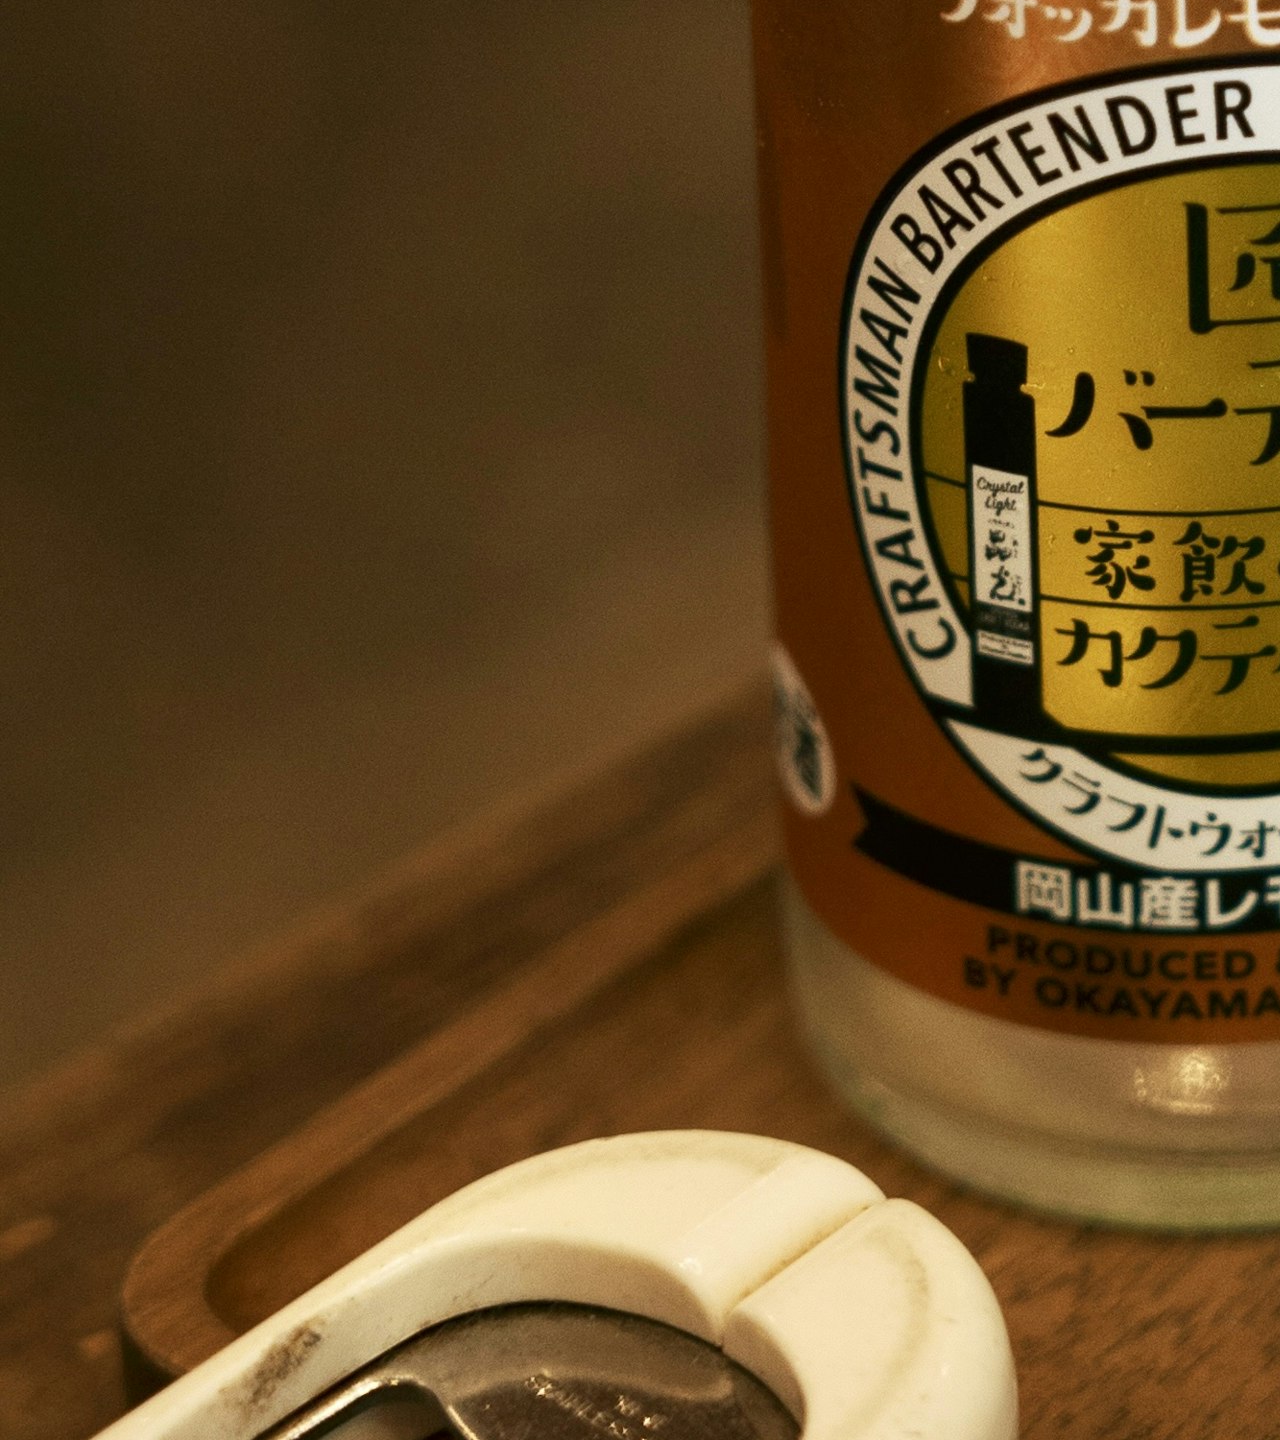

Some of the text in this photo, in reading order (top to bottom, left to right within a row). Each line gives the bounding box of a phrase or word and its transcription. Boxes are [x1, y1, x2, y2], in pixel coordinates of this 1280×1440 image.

[889, 80, 1257, 275] BARTENDER
[852, 255, 958, 661] CRAFTSMAN
[975, 474, 1025, 498] Crystal
[984, 495, 1018, 517] Light
[963, 956, 1017, 998] BY
[985, 925, 1257, 983] PRODUCED
